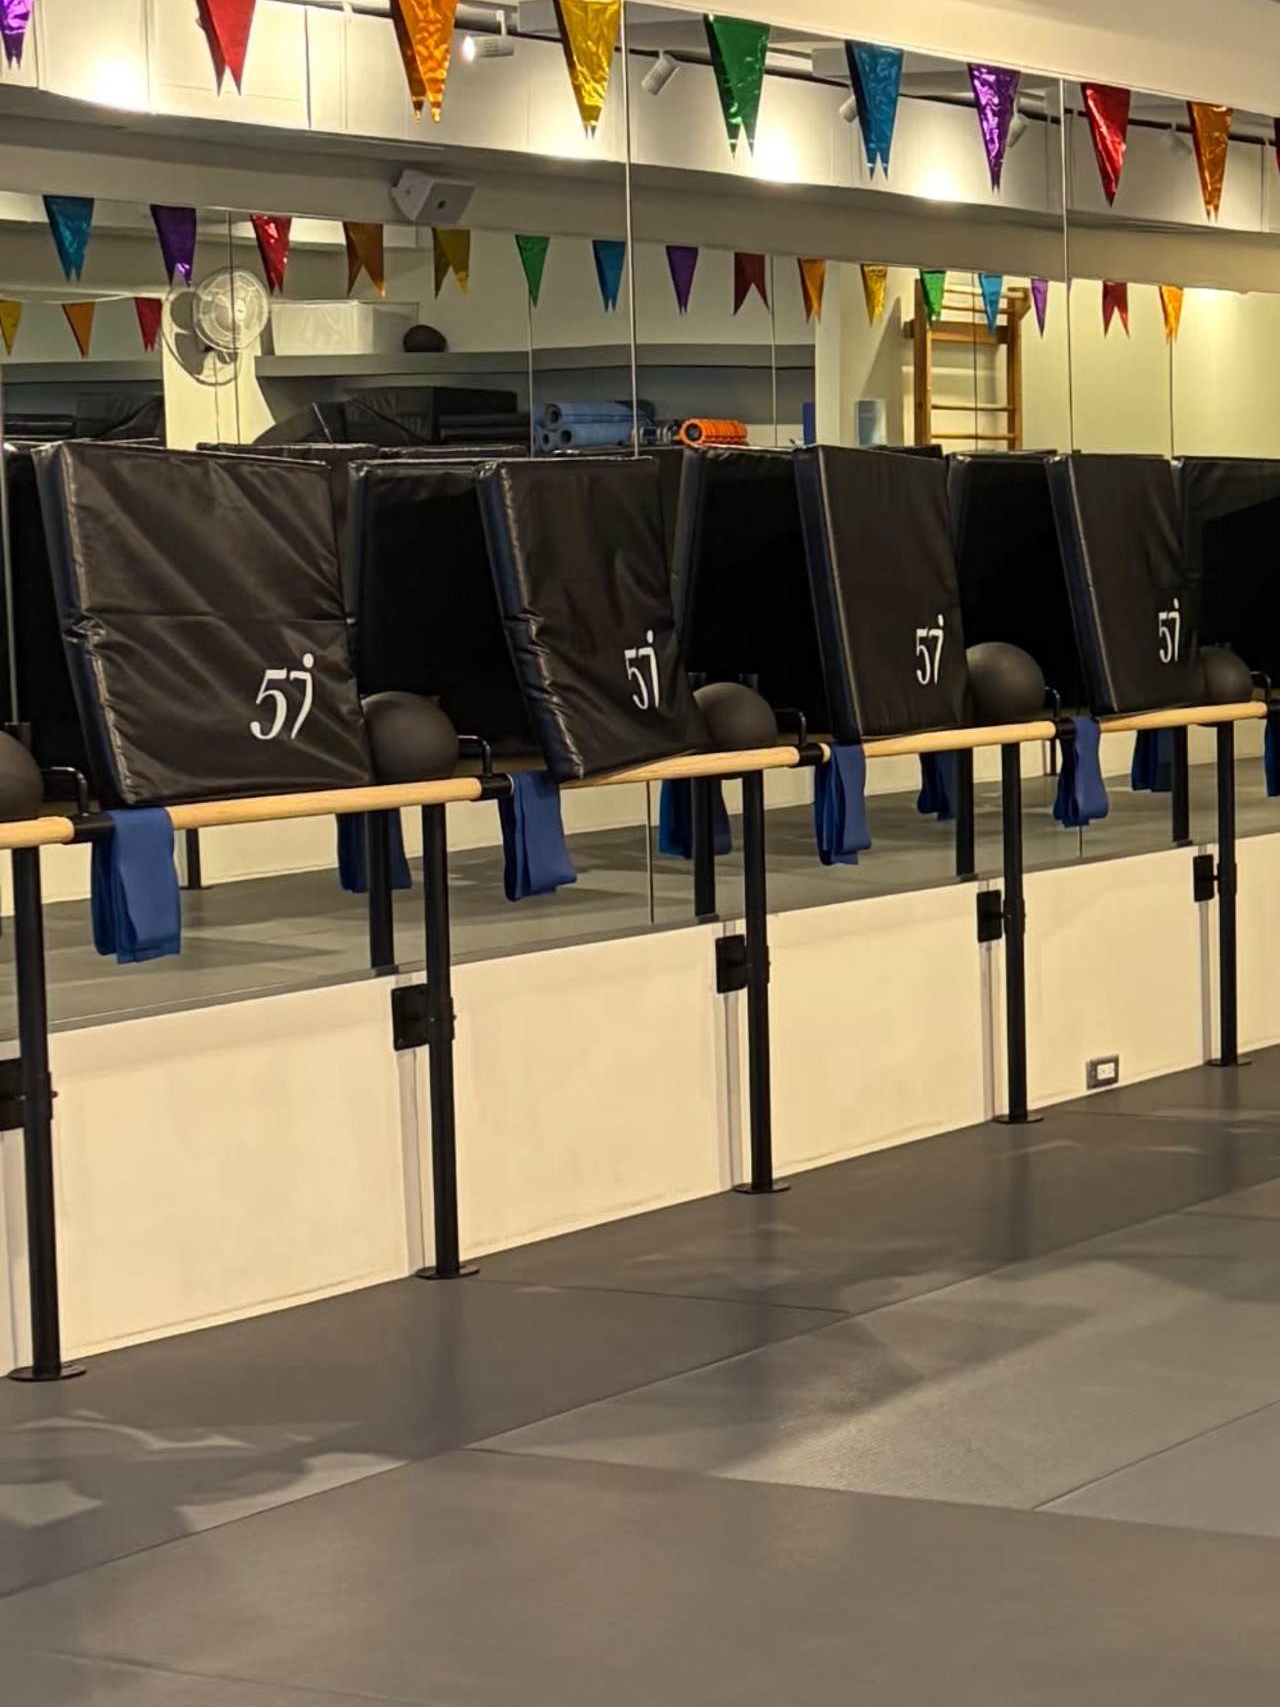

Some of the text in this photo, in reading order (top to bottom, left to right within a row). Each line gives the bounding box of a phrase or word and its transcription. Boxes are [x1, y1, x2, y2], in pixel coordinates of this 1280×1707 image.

[916, 614, 944, 685] 57
[1158, 598, 1180, 663] 57
[249, 652, 315, 740] 57
[623, 630, 659, 711] 57
